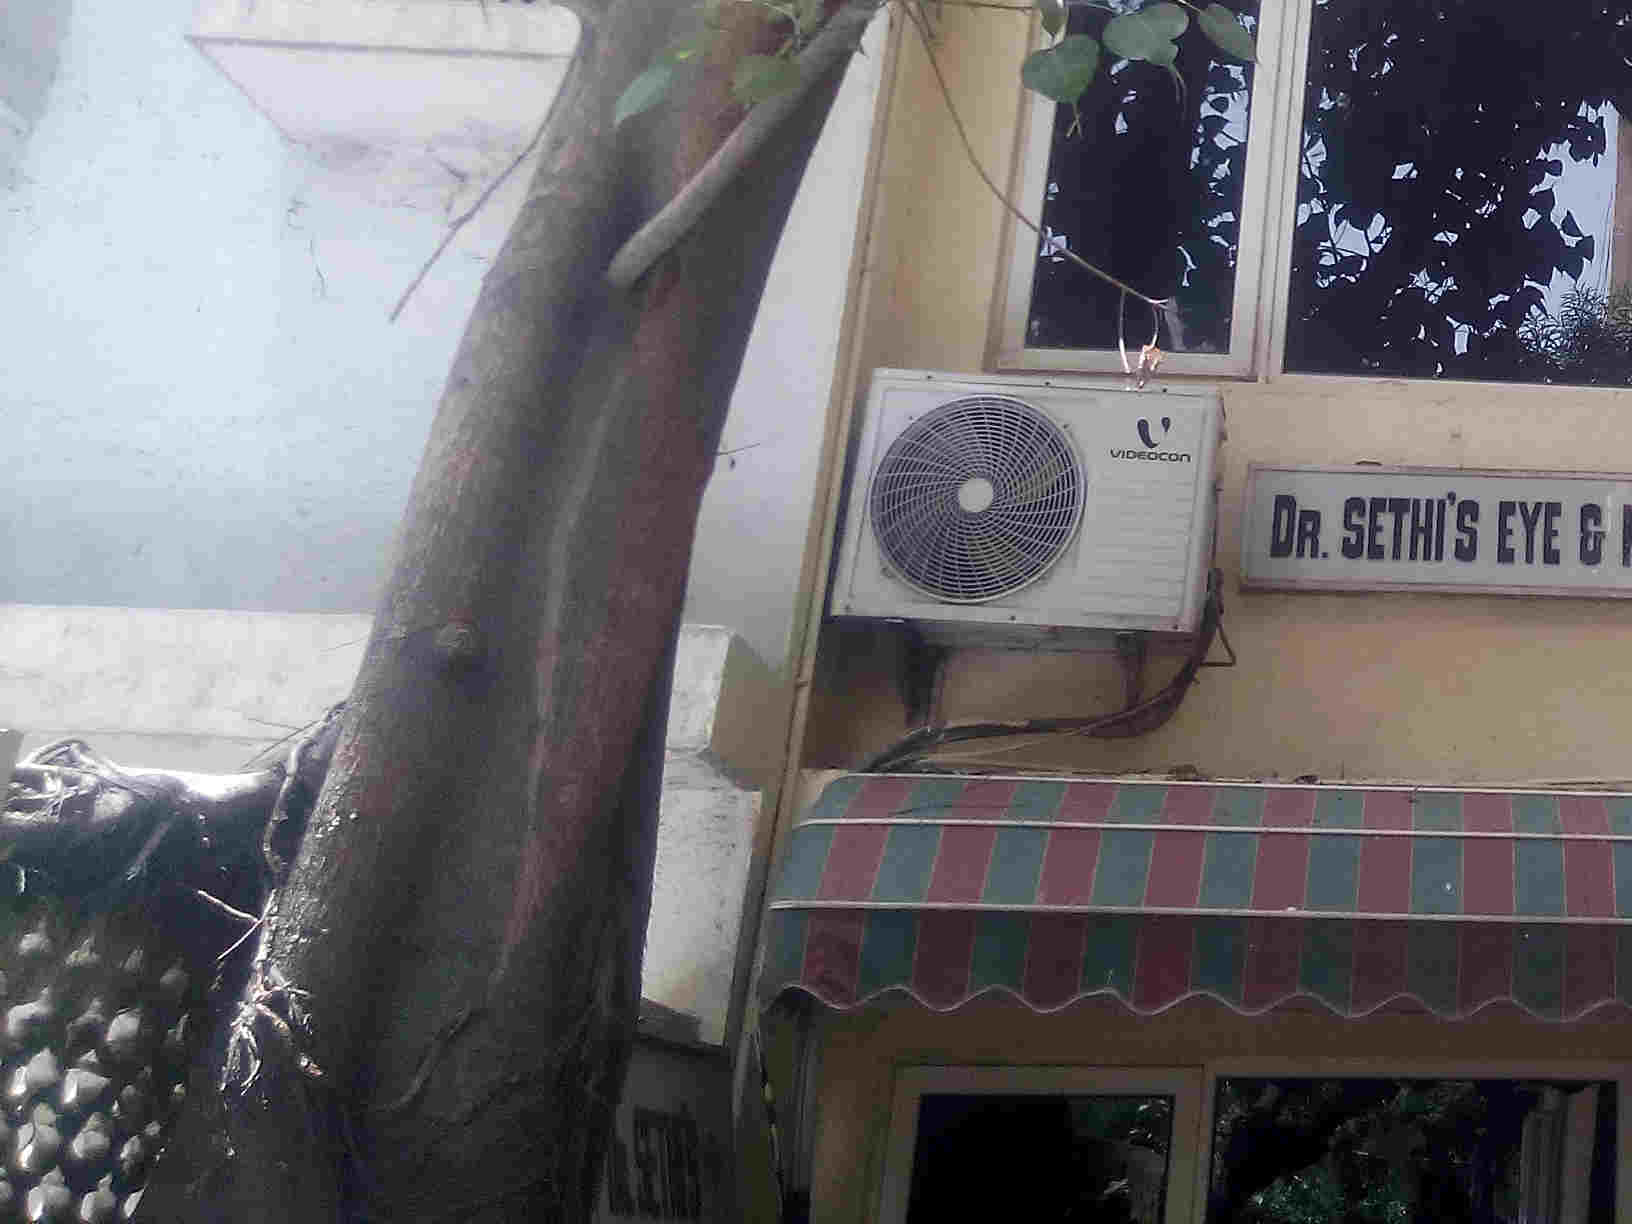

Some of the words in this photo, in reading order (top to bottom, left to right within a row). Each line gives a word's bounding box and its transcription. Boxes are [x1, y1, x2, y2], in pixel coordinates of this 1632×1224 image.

[1341, 492, 1480, 563] SETHI'S
[1497, 501, 1562, 565] EYE
[1580, 503, 1606, 566] &
